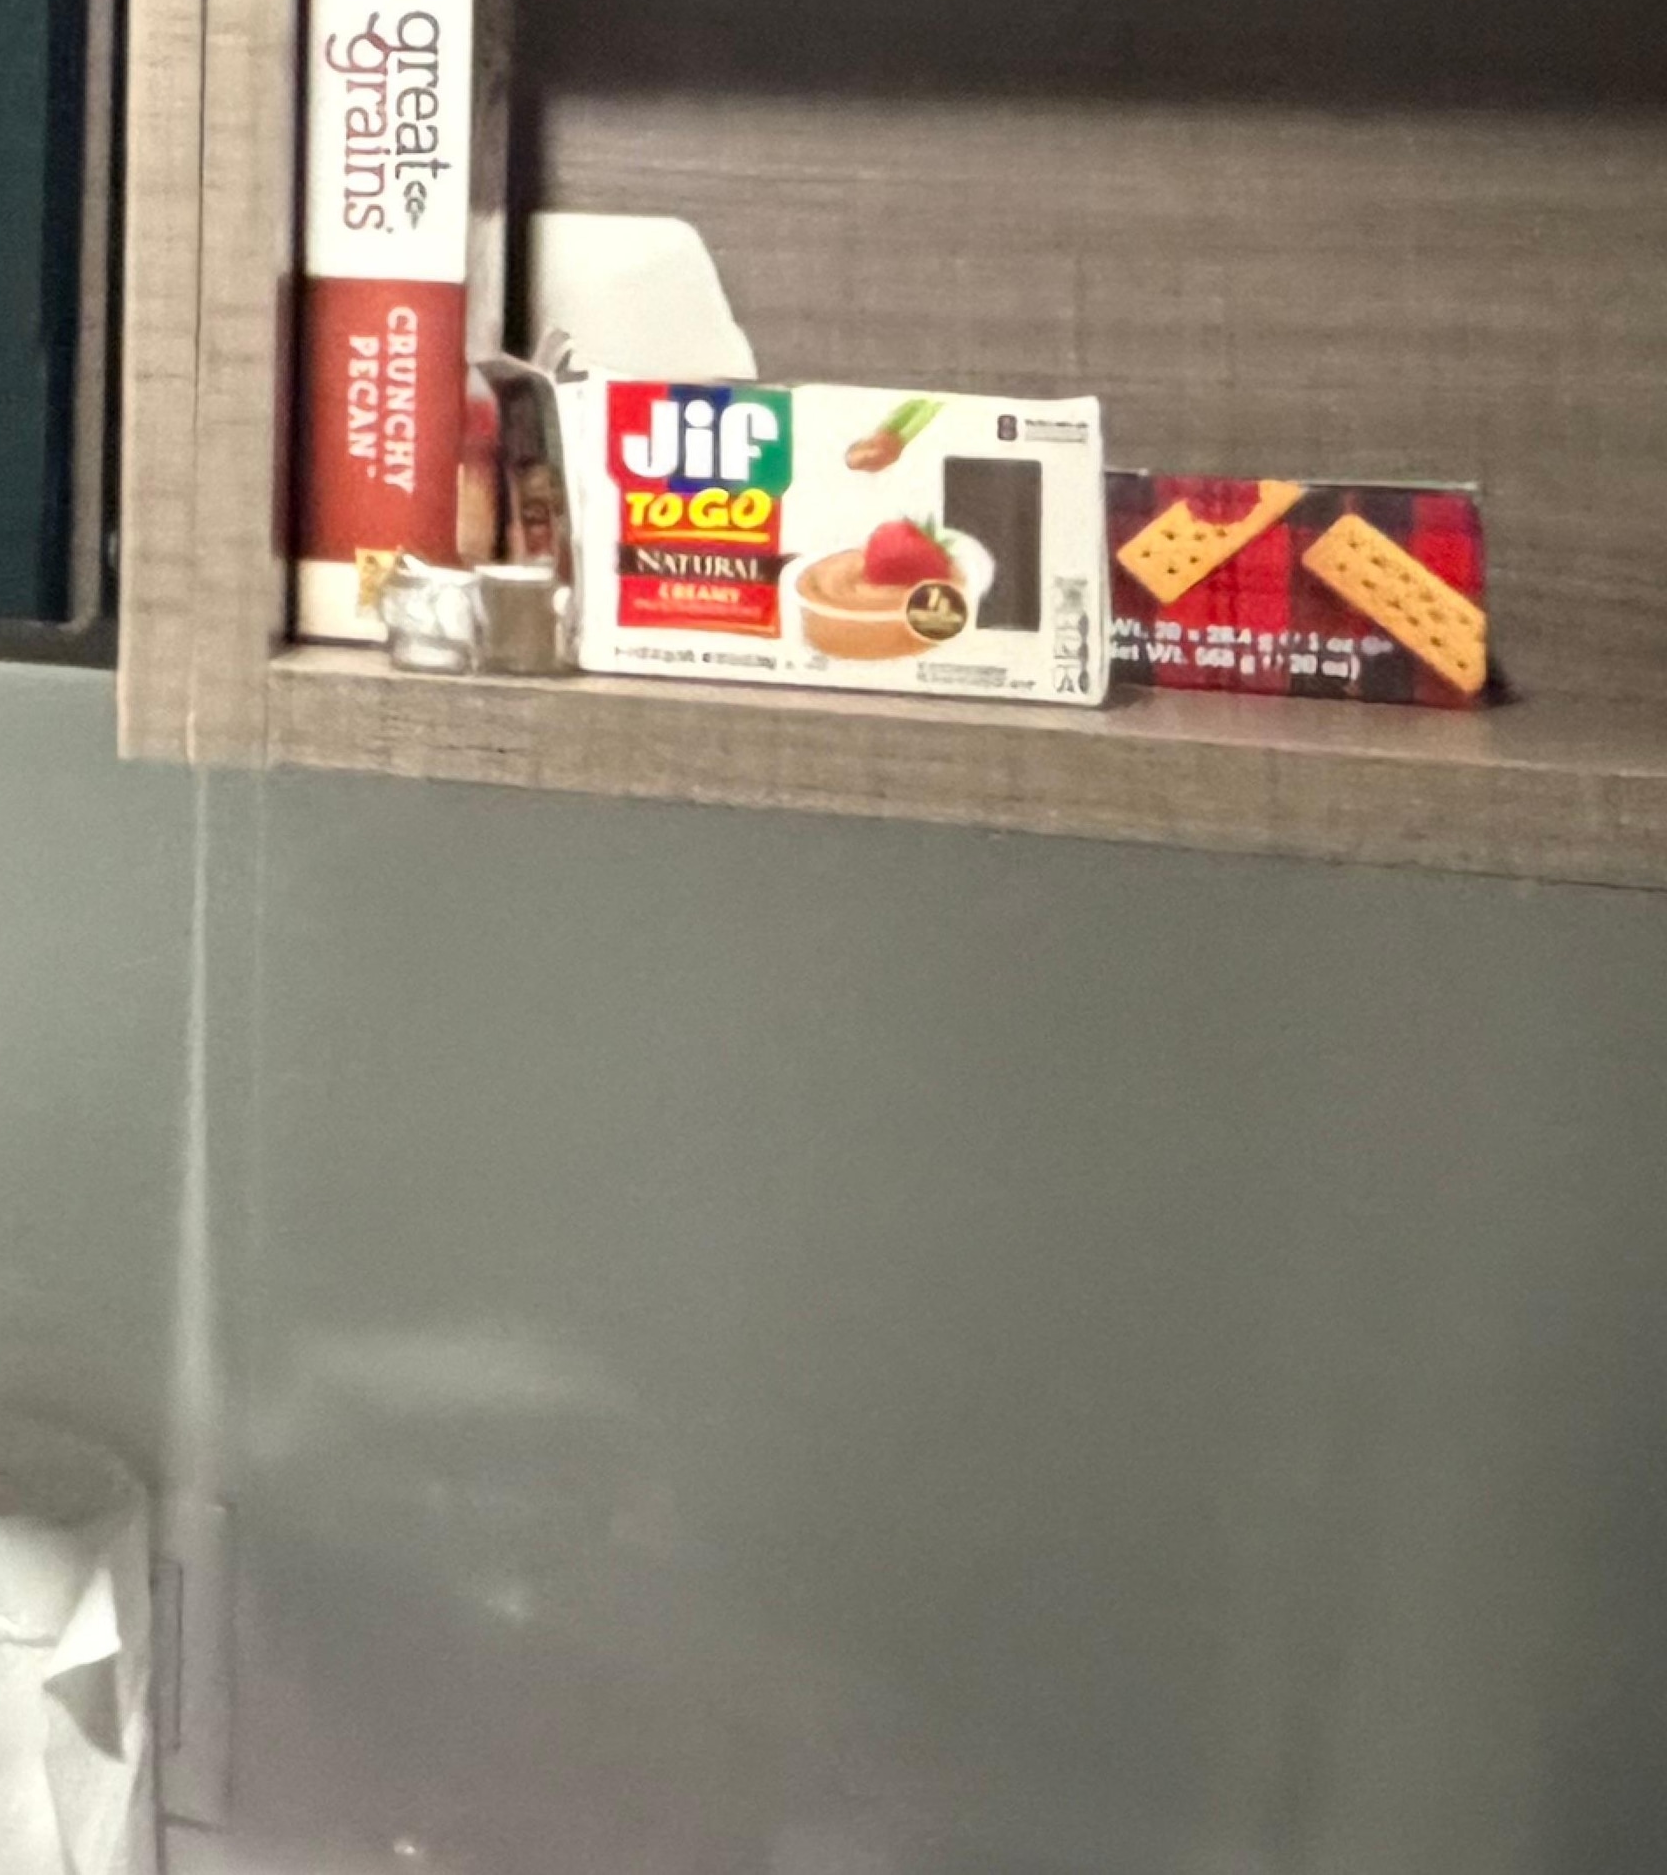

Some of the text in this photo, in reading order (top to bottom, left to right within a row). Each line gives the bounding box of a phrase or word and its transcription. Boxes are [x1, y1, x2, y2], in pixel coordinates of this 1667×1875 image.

[324, 31, 393, 232] grains
[365, 10, 451, 179] great
[347, 335, 379, 459] PECAN
[384, 306, 418, 495] CRUNCHY
[622, 400, 778, 481] Jif
[626, 487, 772, 528] TO GO
[636, 548, 764, 579] NATURAL
